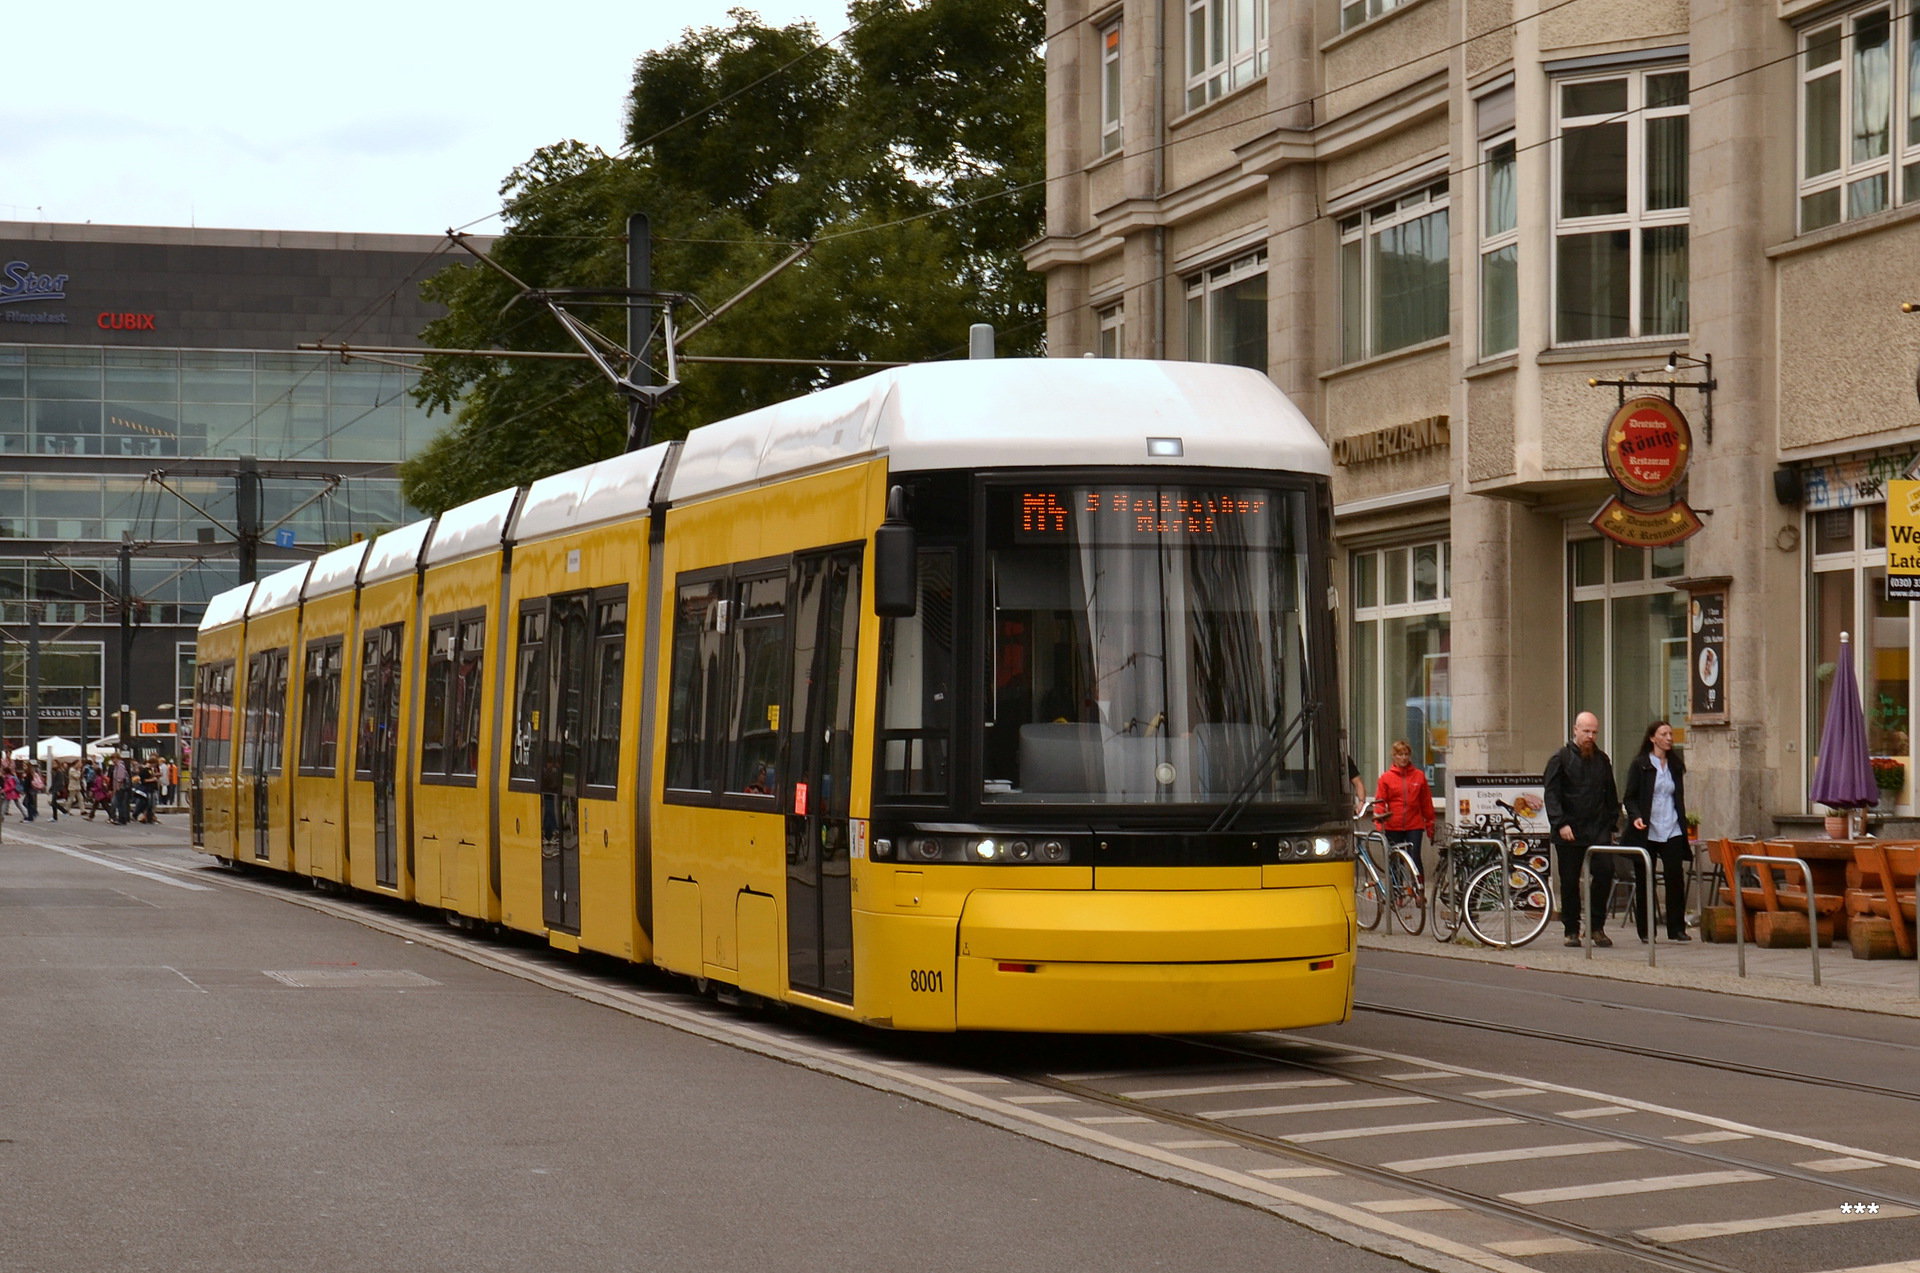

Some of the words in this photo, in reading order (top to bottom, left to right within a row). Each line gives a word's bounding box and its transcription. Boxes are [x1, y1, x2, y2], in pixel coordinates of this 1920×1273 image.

[0, 261, 68, 295] Star
[97, 312, 156, 330] CUBIX
[1332, 415, 1449, 466] COMMERZBANK
[1629, 456, 1670, 465] Restaurant
[1640, 521, 1690, 540] Restaurant
[38, 709, 81, 717] cktailba
[911, 969, 943, 992] 8001
